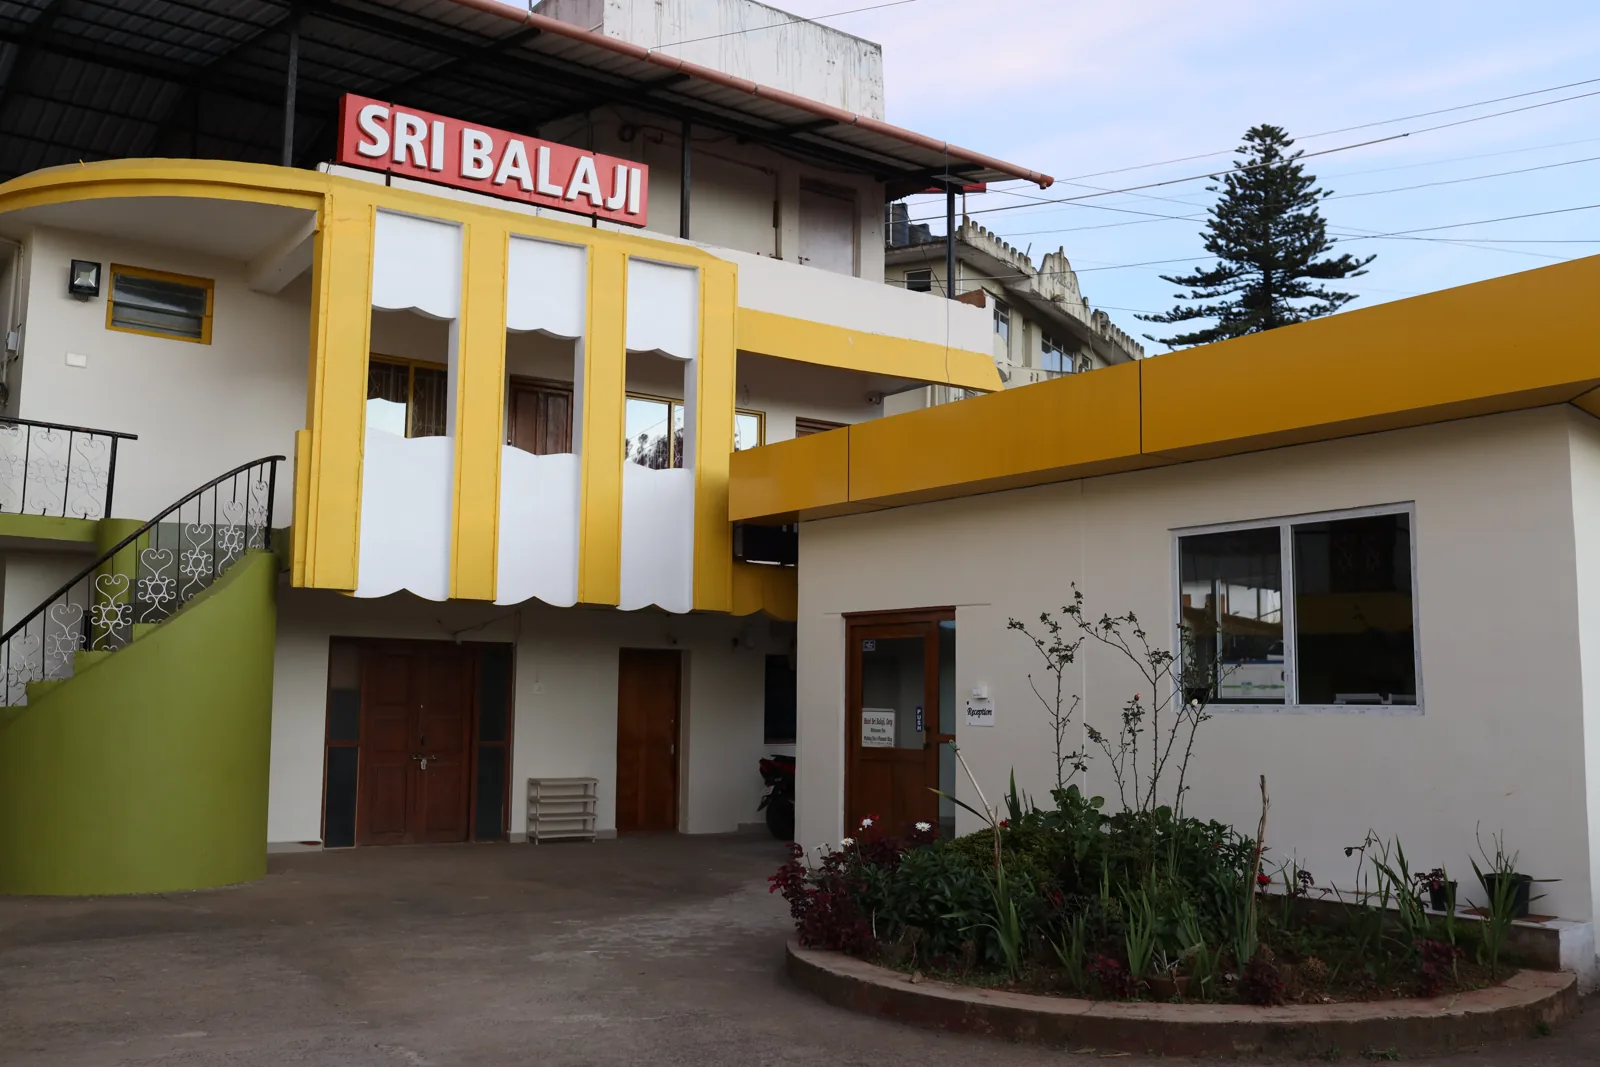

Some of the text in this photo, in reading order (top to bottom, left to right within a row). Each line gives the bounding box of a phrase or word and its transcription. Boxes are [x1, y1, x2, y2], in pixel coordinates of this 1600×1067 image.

[357, 104, 642, 215] SRI BALAJI
[967, 707, 992, 718] Reception
